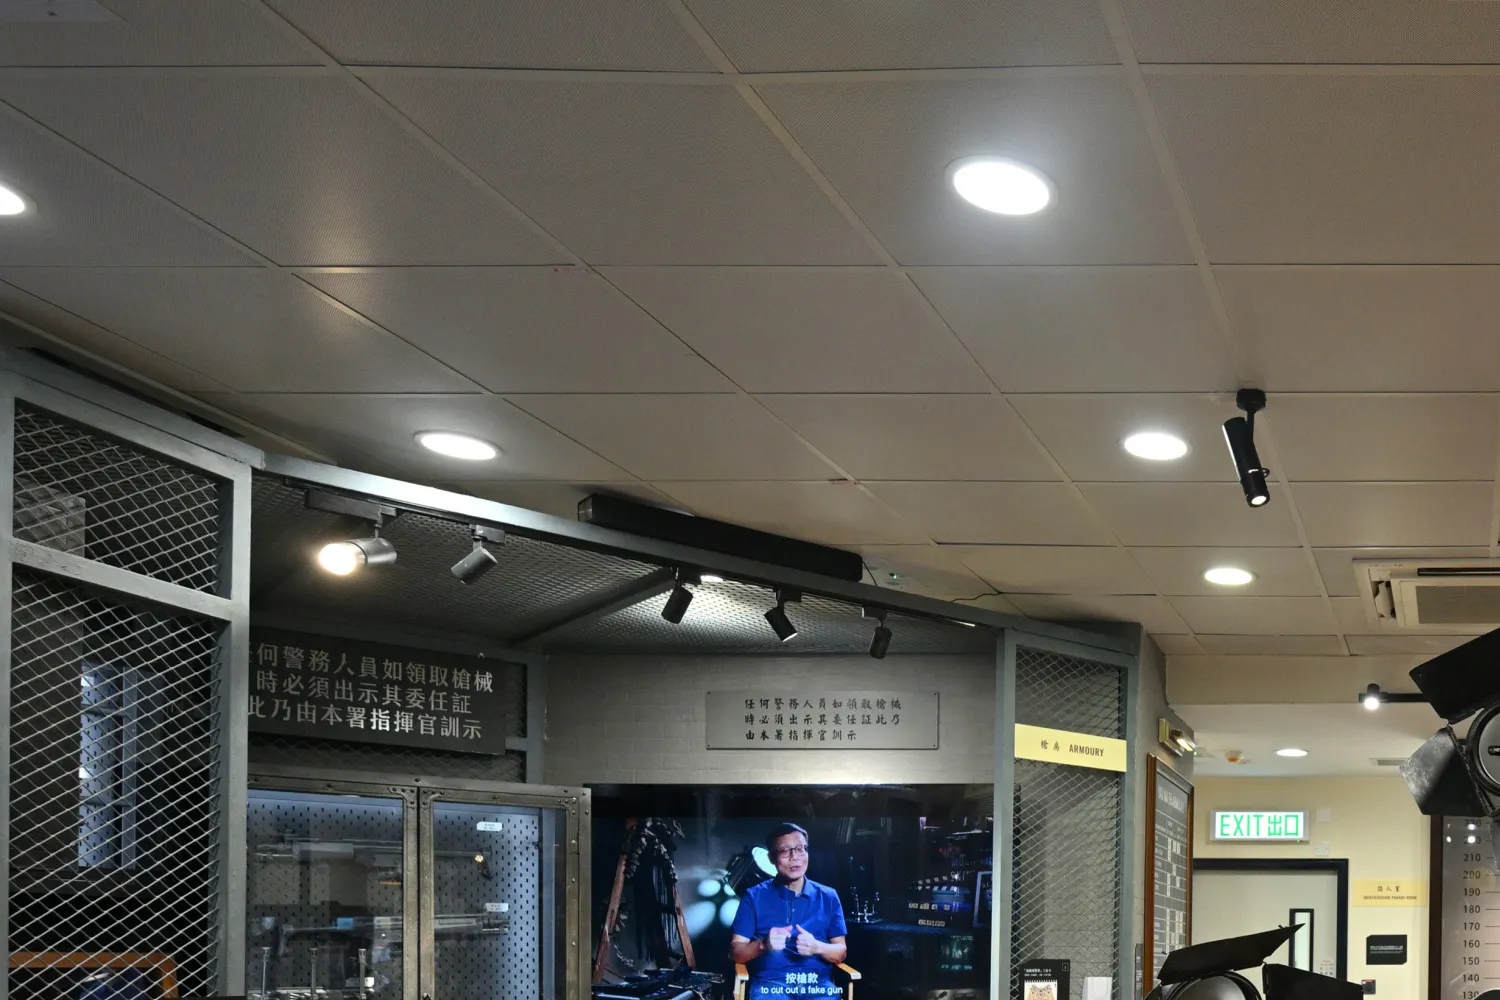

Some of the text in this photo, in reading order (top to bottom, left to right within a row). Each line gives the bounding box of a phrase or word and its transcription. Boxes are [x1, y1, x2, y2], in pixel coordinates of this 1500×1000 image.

[249, 642, 493, 693] 何警務人員如領取槍械
[256, 670, 472, 714] 時必須出示其委任証
[744, 698, 902, 710] 任何警務人員如領取槍械
[248, 695, 482, 739] 此乃由本署指揮官訓示
[744, 714, 902, 725] 時必須出示其委任証此乃
[744, 729, 858, 741] 由本署指揮官訓示
[1069, 744, 1104, 757] ARMOURY
[1220, 814, 1299, 836] EXIT 出口
[1463, 853, 1481, 862] 210
[1462, 870, 1481, 879] 200
[1463, 887, 1481, 897] 190
[1463, 905, 1481, 914] 180
[1463, 922, 1481, 931] 170
[1463, 939, 1481, 948] 160
[1463, 956, 1480, 965] 150
[1462, 974, 1480, 983] 140
[761, 986, 769, 994] to
[771, 986, 784, 994] cut
[786, 986, 799, 994] out
[808, 985, 825, 994] fake
[827, 987, 843, 996] gun
